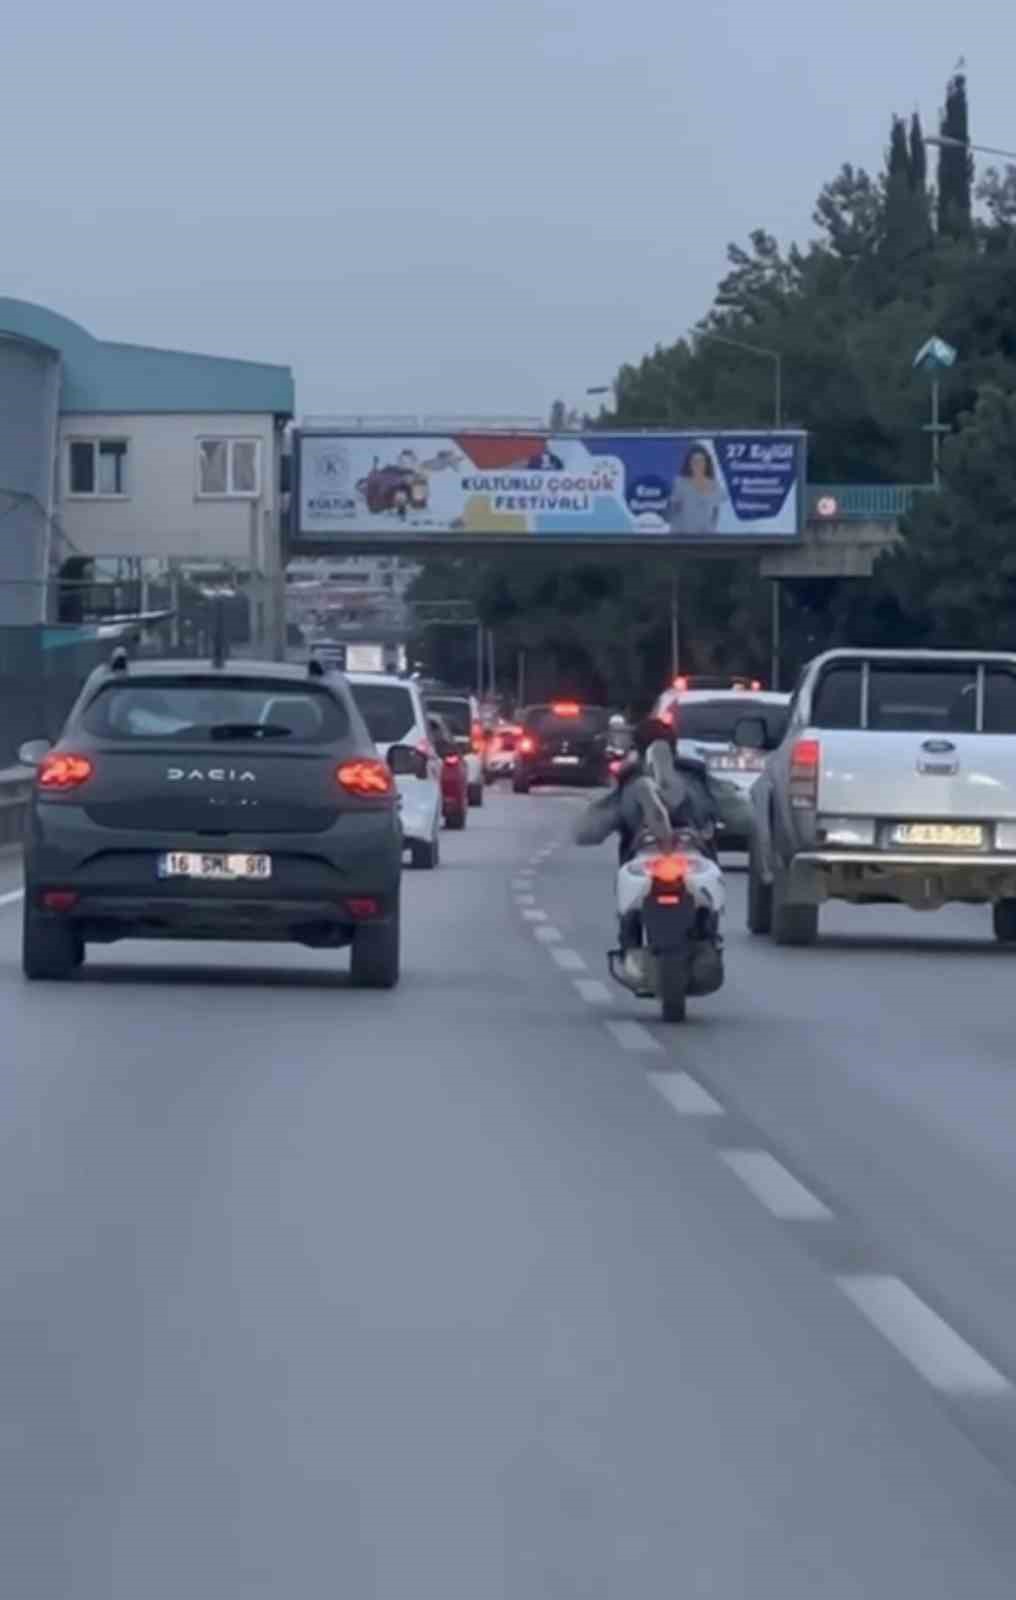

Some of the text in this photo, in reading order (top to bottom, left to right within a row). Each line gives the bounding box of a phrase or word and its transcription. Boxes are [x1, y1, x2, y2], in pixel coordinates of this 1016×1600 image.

[726, 444, 745, 459] 27
[461, 473, 615, 492] KÜLTÜRLÜ ÇOCUK
[167, 767, 256, 781] DACIA
[169, 854, 189, 873] 16
